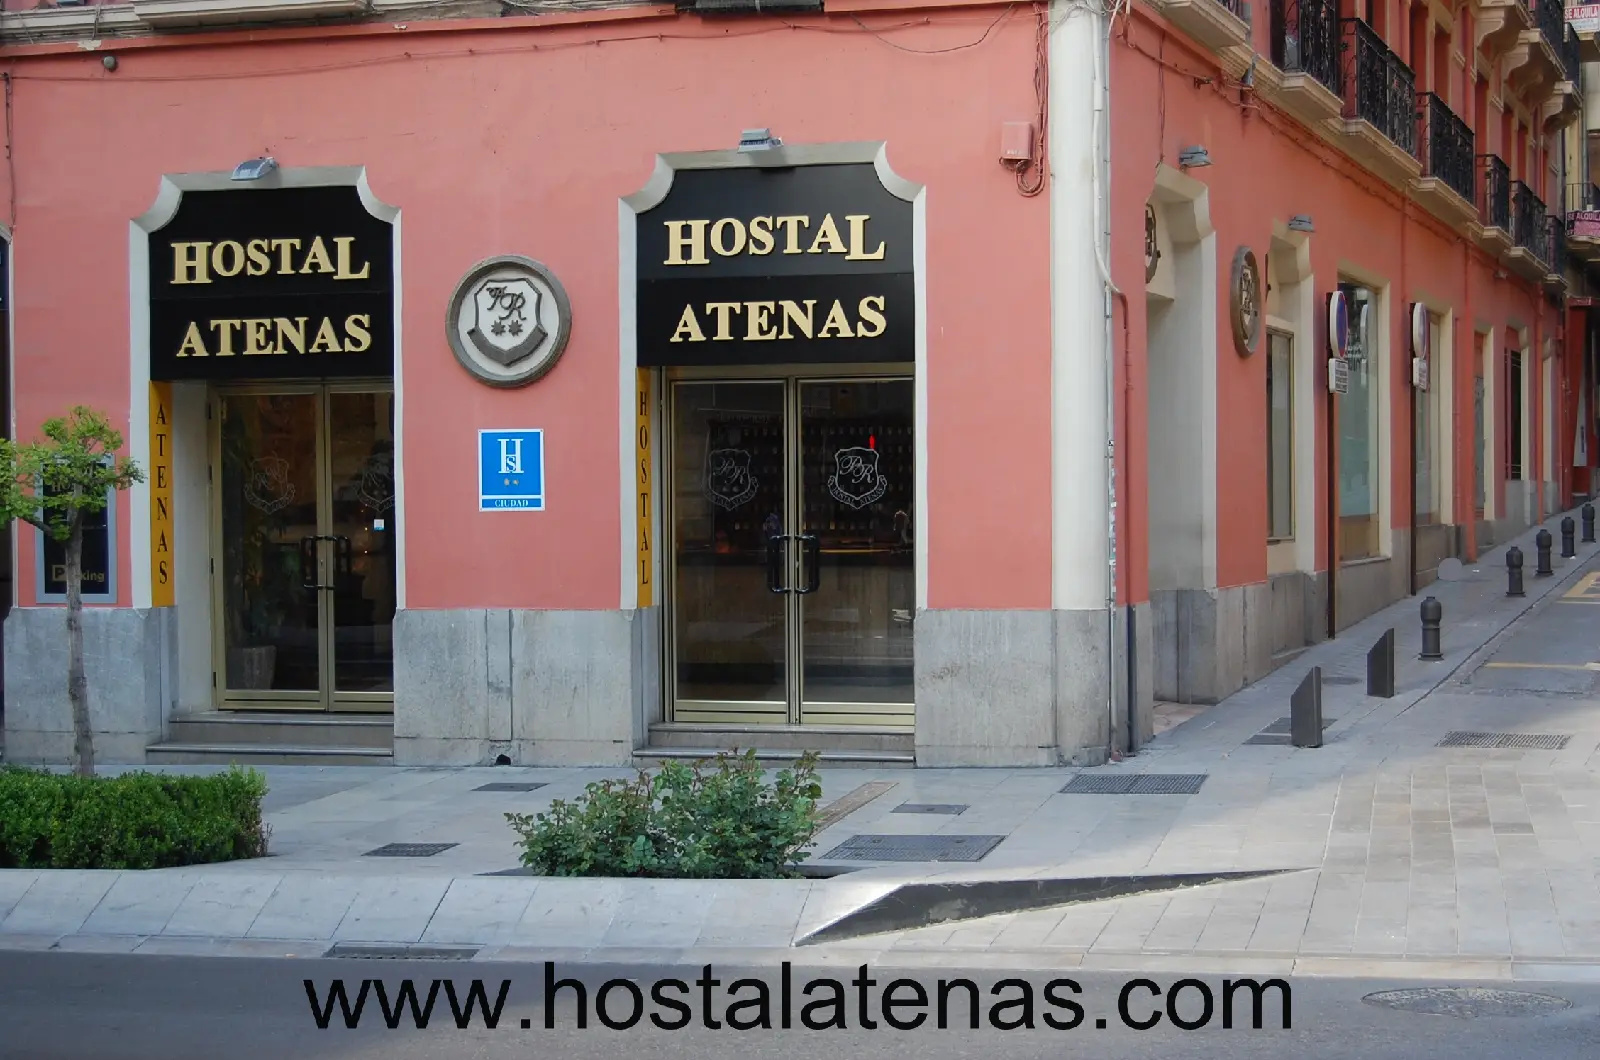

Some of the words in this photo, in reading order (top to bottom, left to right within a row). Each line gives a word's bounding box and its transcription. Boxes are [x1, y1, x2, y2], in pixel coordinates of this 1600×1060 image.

[1564, 9, 1573, 19] SE
[1573, 5, 1598, 19] ALQUILA
[170, 236, 370, 285] HOSTAL
[664, 214, 885, 265] HOSTAL
[177, 314, 371, 357] ATENAS
[670, 296, 887, 343] ATENAS
[156, 403, 168, 585] ATENAS
[494, 499, 529, 508] CIUDAD
[639, 391, 649, 585] HOSTAL
[52, 564, 105, 583] Pking
